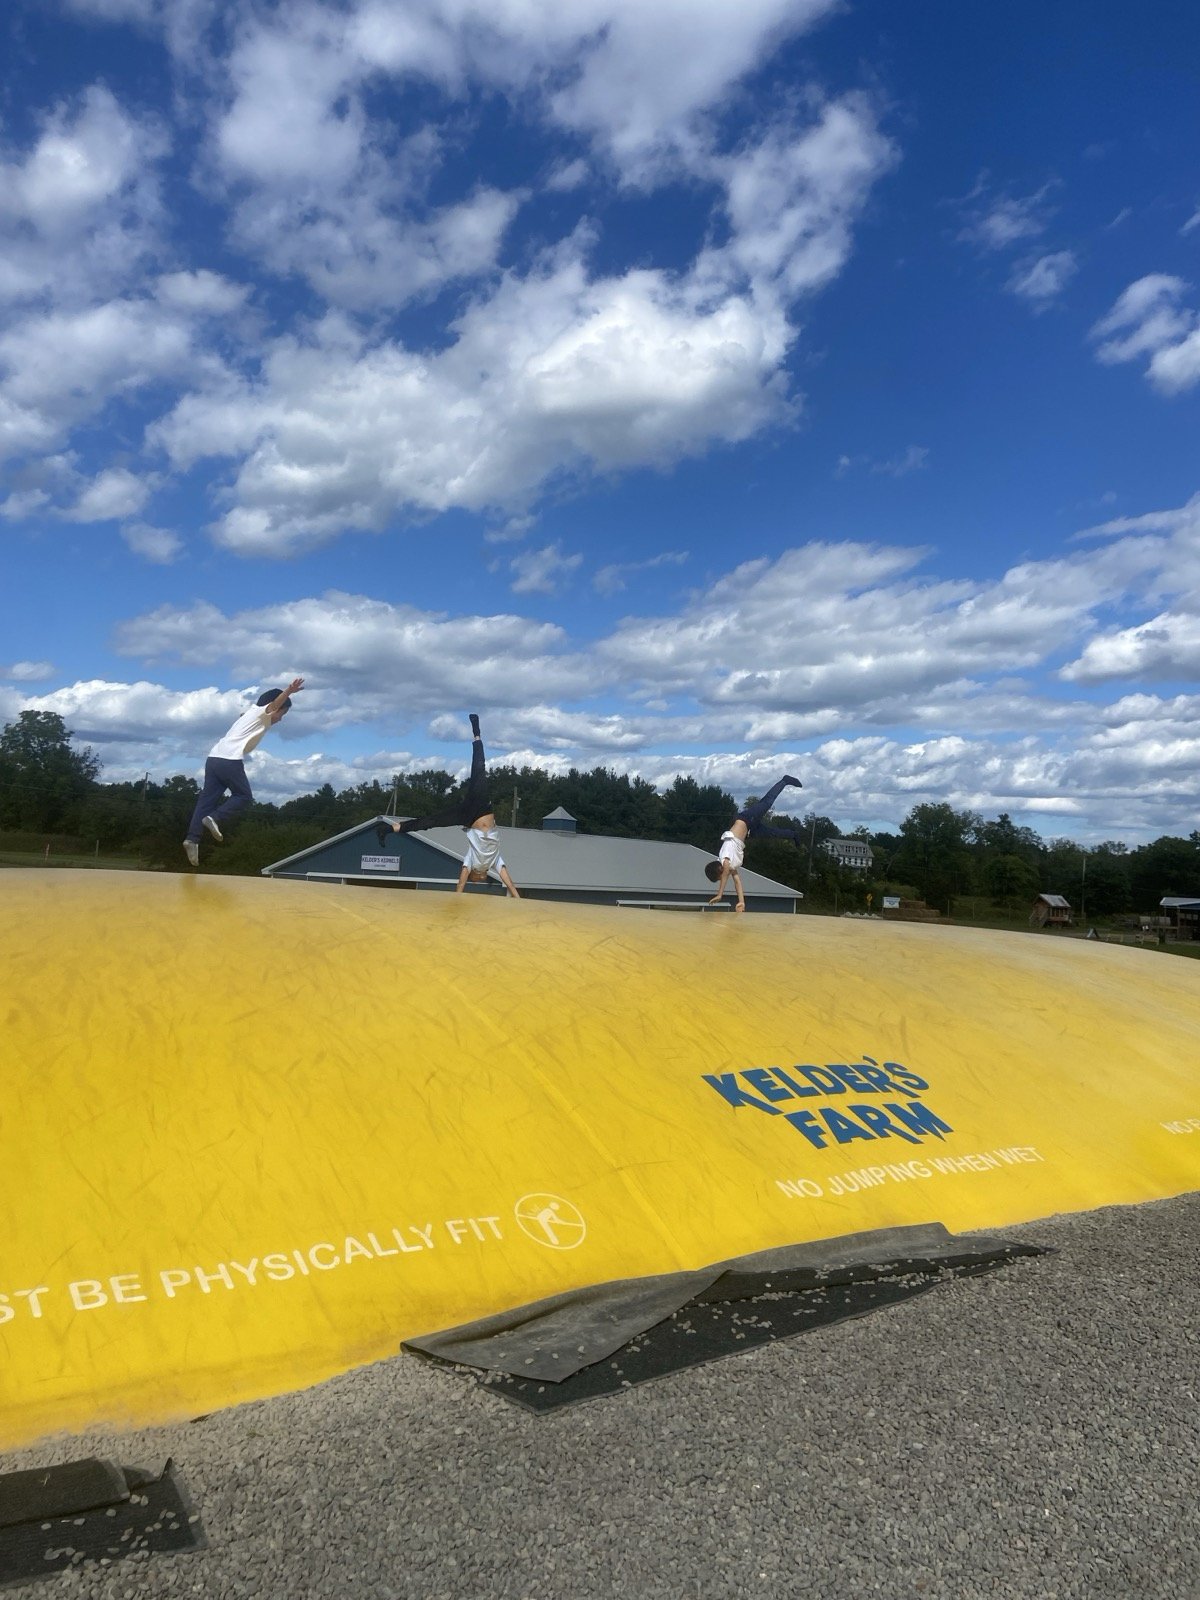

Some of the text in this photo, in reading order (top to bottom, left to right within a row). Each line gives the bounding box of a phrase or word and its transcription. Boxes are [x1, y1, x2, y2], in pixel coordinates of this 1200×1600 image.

[701, 1056, 929, 1115] KELDER'S
[783, 1102, 954, 1149] FARM
[1160, 1120, 1193, 1135] NO
[776, 1147, 1045, 1199] NO JUMPING WHEN WET
[69, 1274, 147, 1311] BE
[160, 1223, 434, 1298] PHYSICALLY
[446, 1216, 504, 1245] FIT
